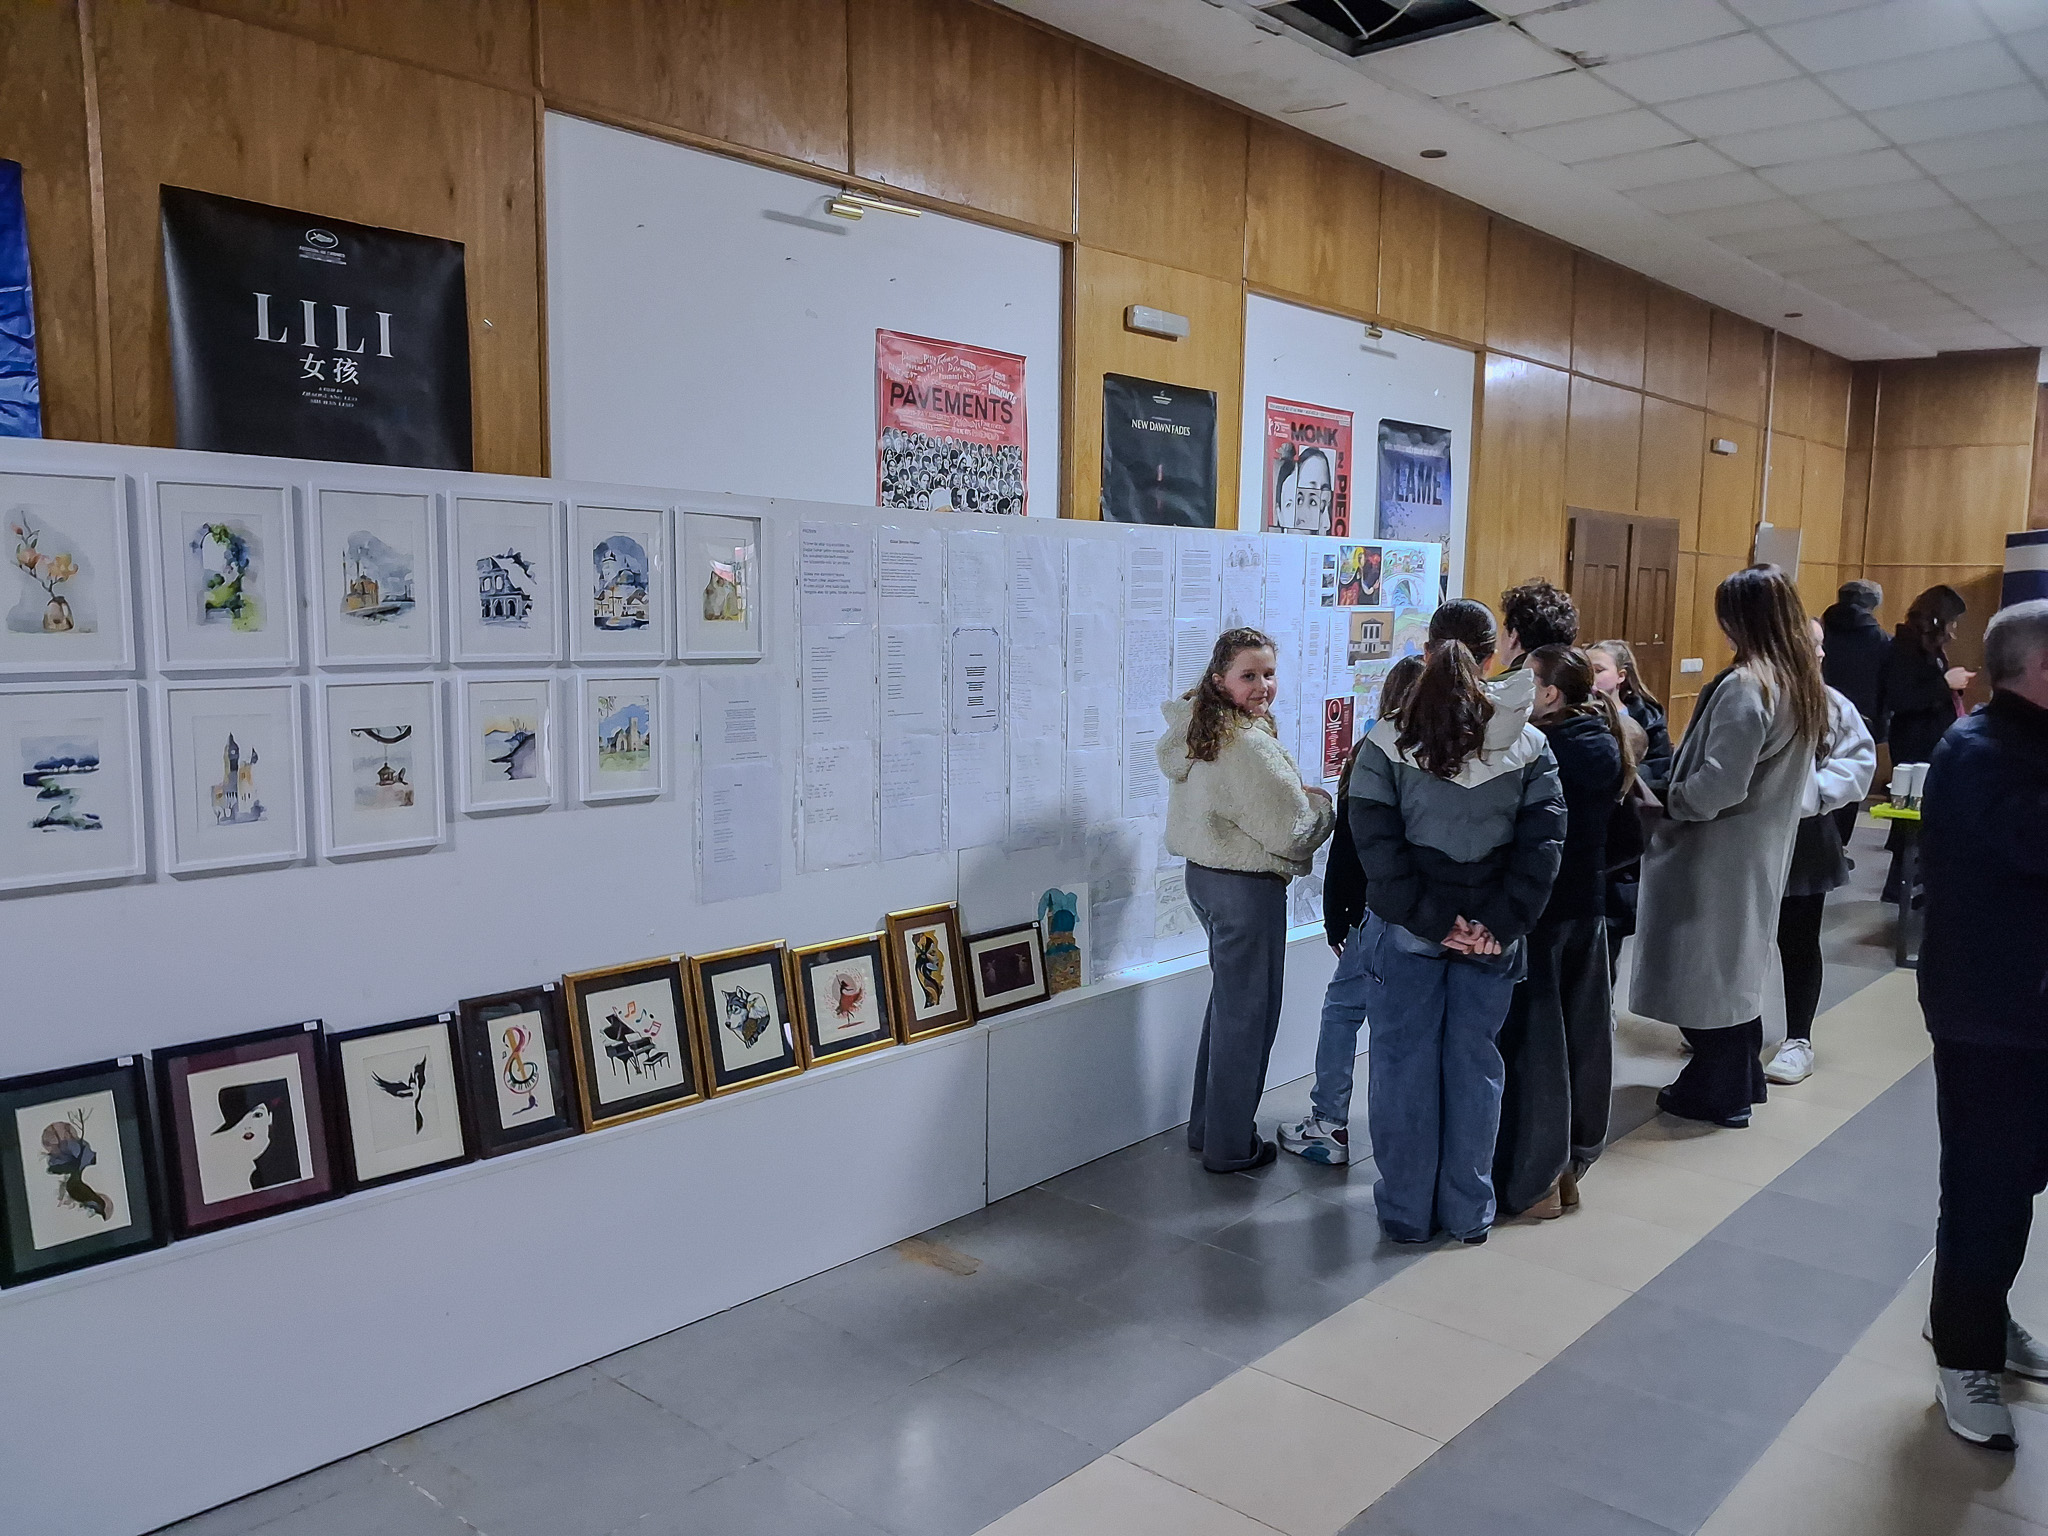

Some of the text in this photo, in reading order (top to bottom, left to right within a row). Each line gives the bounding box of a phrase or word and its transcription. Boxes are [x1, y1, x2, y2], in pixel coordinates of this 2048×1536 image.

[252, 292, 394, 358] LILI
[299, 352, 360, 385] 女孩
[889, 382, 1014, 425] PAVEMENTS
[1131, 418, 1191, 436] NEW DAWN FADES
[1290, 421, 1339, 447] MONK
[1385, 460, 1443, 506] LAME
